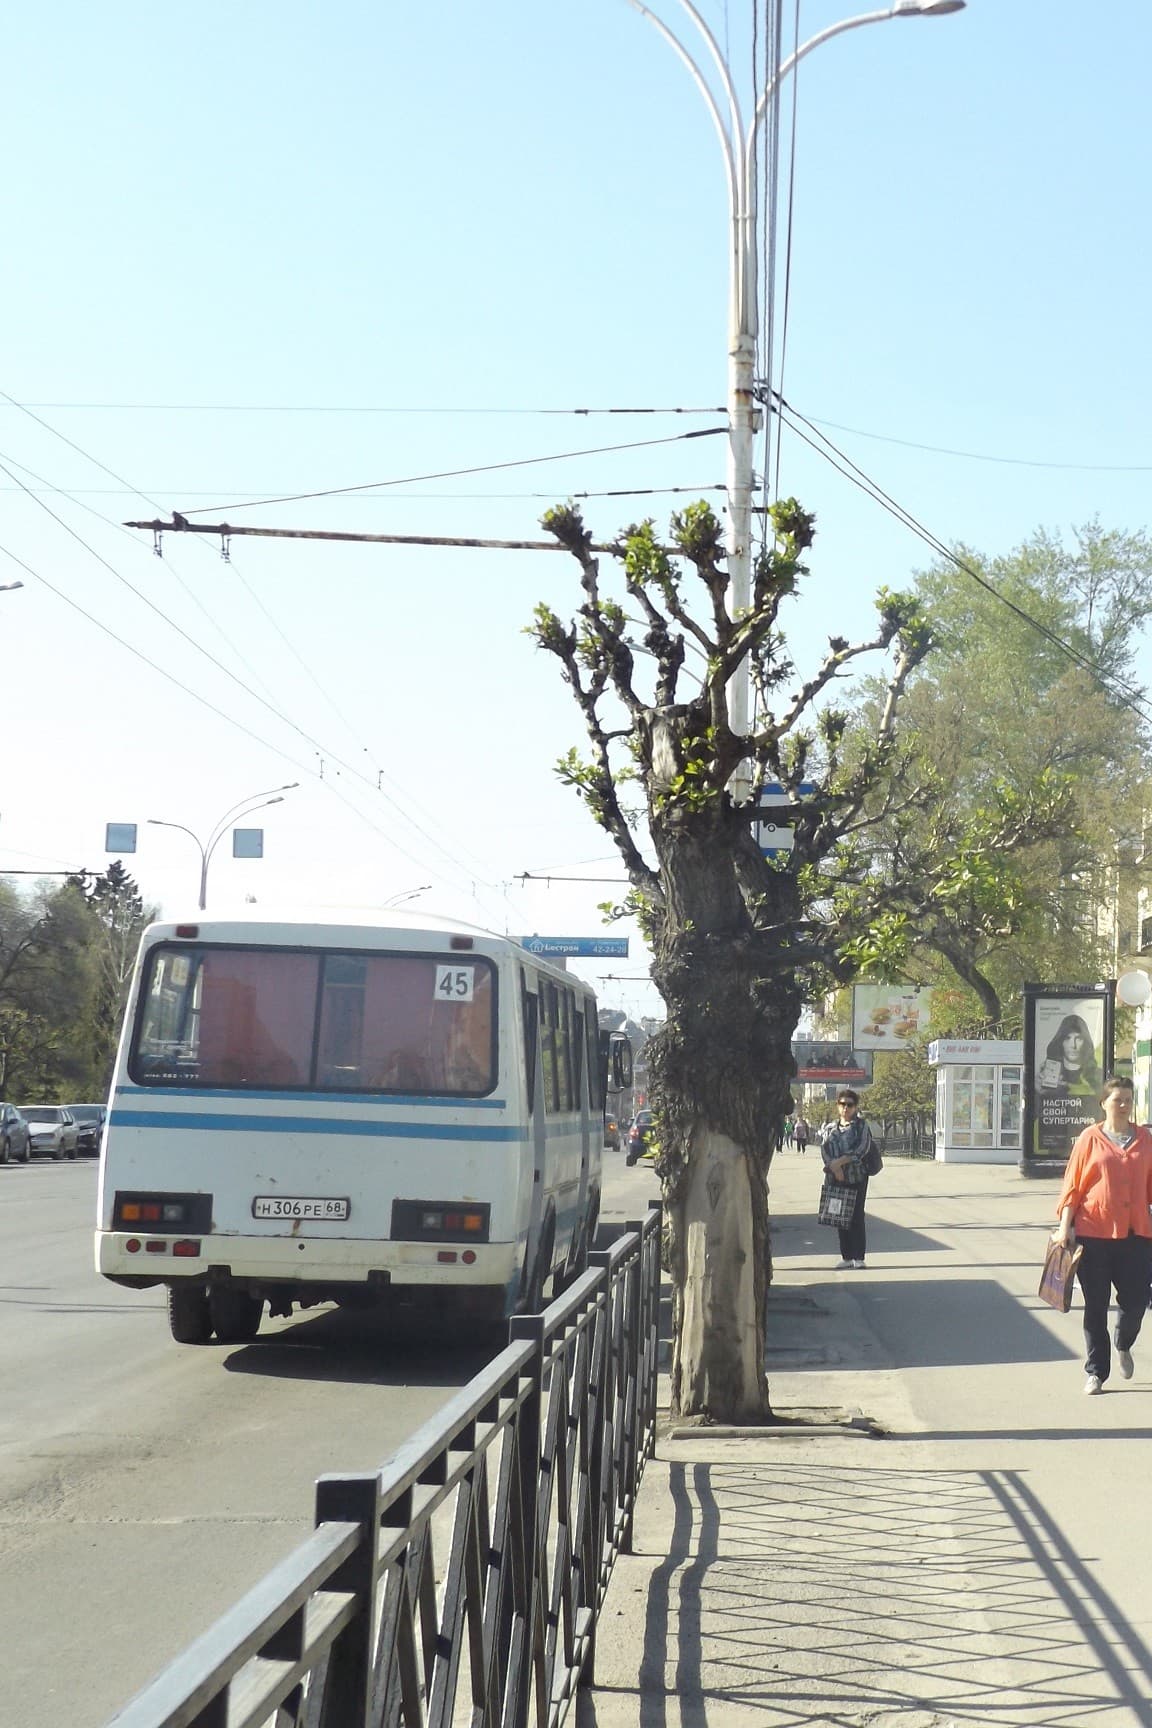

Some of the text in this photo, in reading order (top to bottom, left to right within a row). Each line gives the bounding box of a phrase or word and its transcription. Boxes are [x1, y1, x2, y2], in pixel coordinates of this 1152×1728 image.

[439, 971, 468, 996] 45
[1042, 1098, 1082, 1107] НАСТРОЙ
[1042, 1107, 1067, 1116] СВОЙ
[1042, 1116, 1096, 1125] СУПЕРТАРИФ
